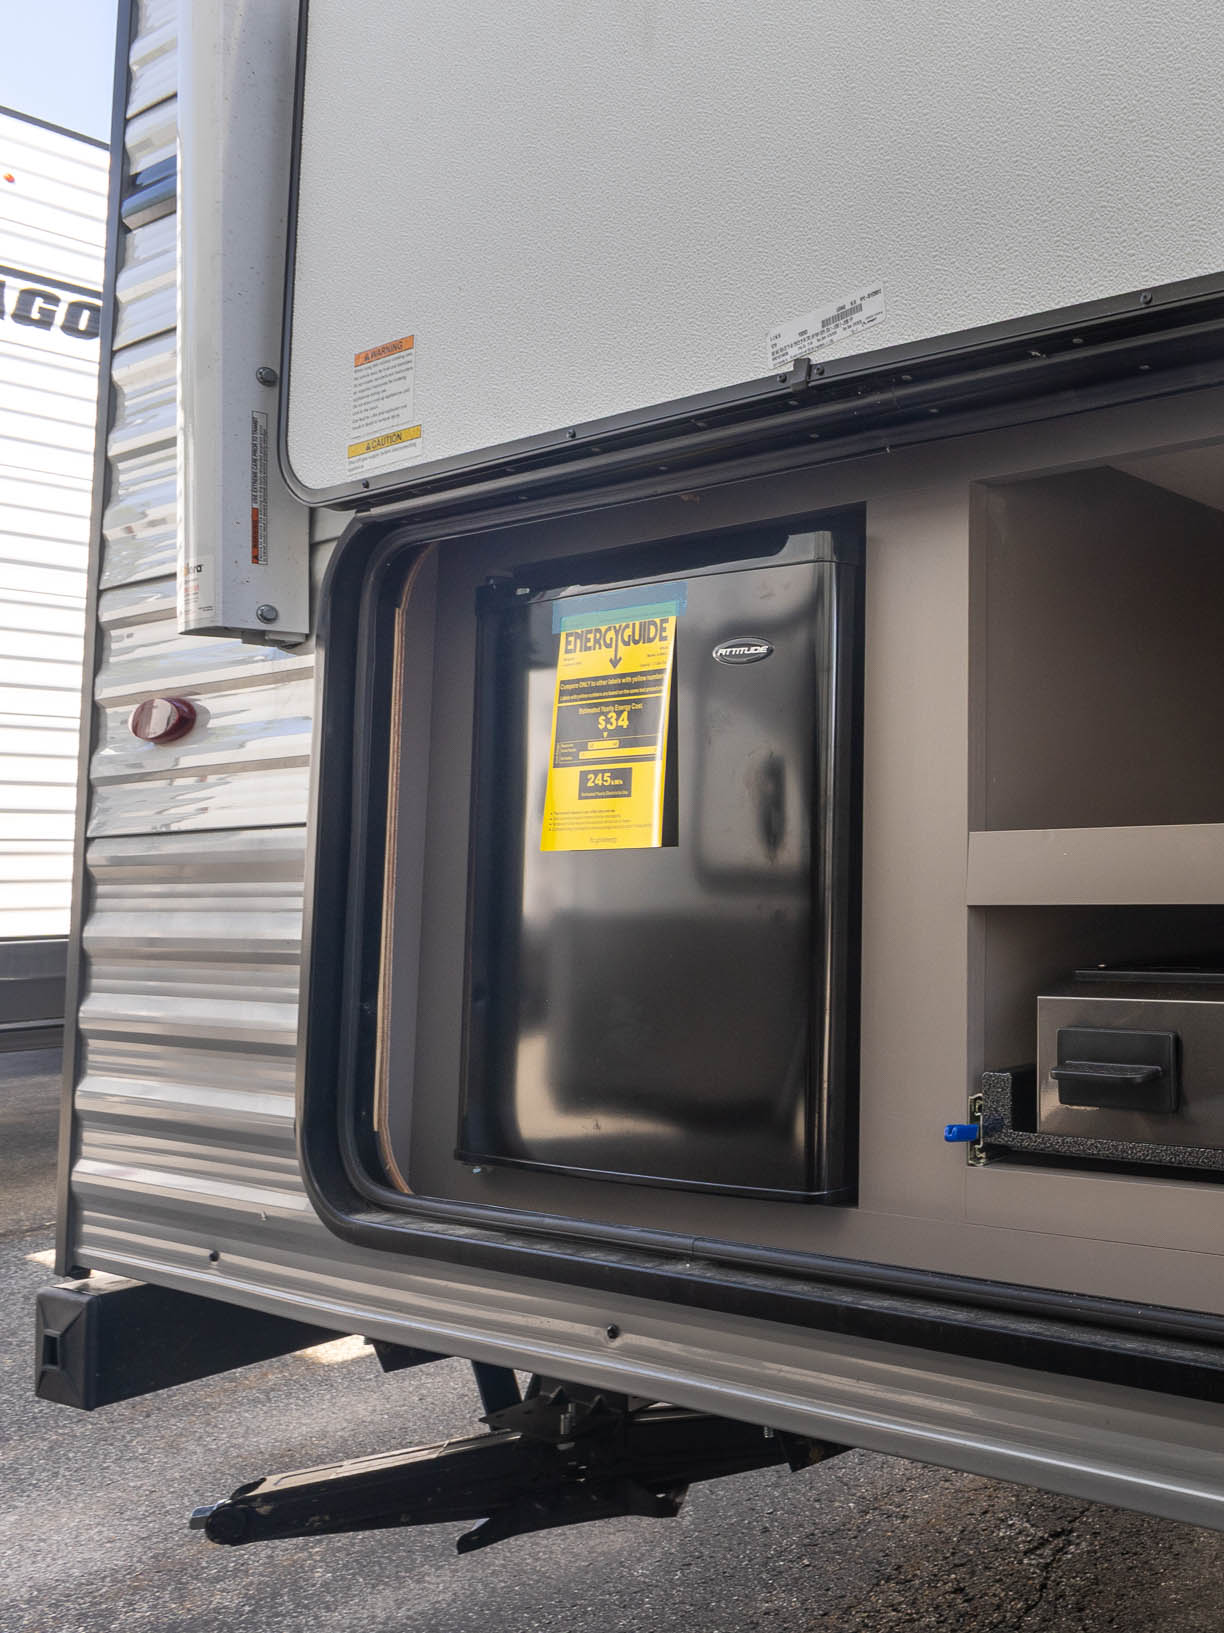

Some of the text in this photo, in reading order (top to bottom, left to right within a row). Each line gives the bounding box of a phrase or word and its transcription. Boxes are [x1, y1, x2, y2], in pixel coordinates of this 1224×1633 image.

[370, 340, 403, 358] WARNING
[371, 431, 403, 449] CAUTION
[564, 617, 669, 655] ENERGYGUIDE
[717, 645, 769, 656] ATTITUDE
[598, 711, 629, 730] $34
[587, 772, 611, 787] 245
